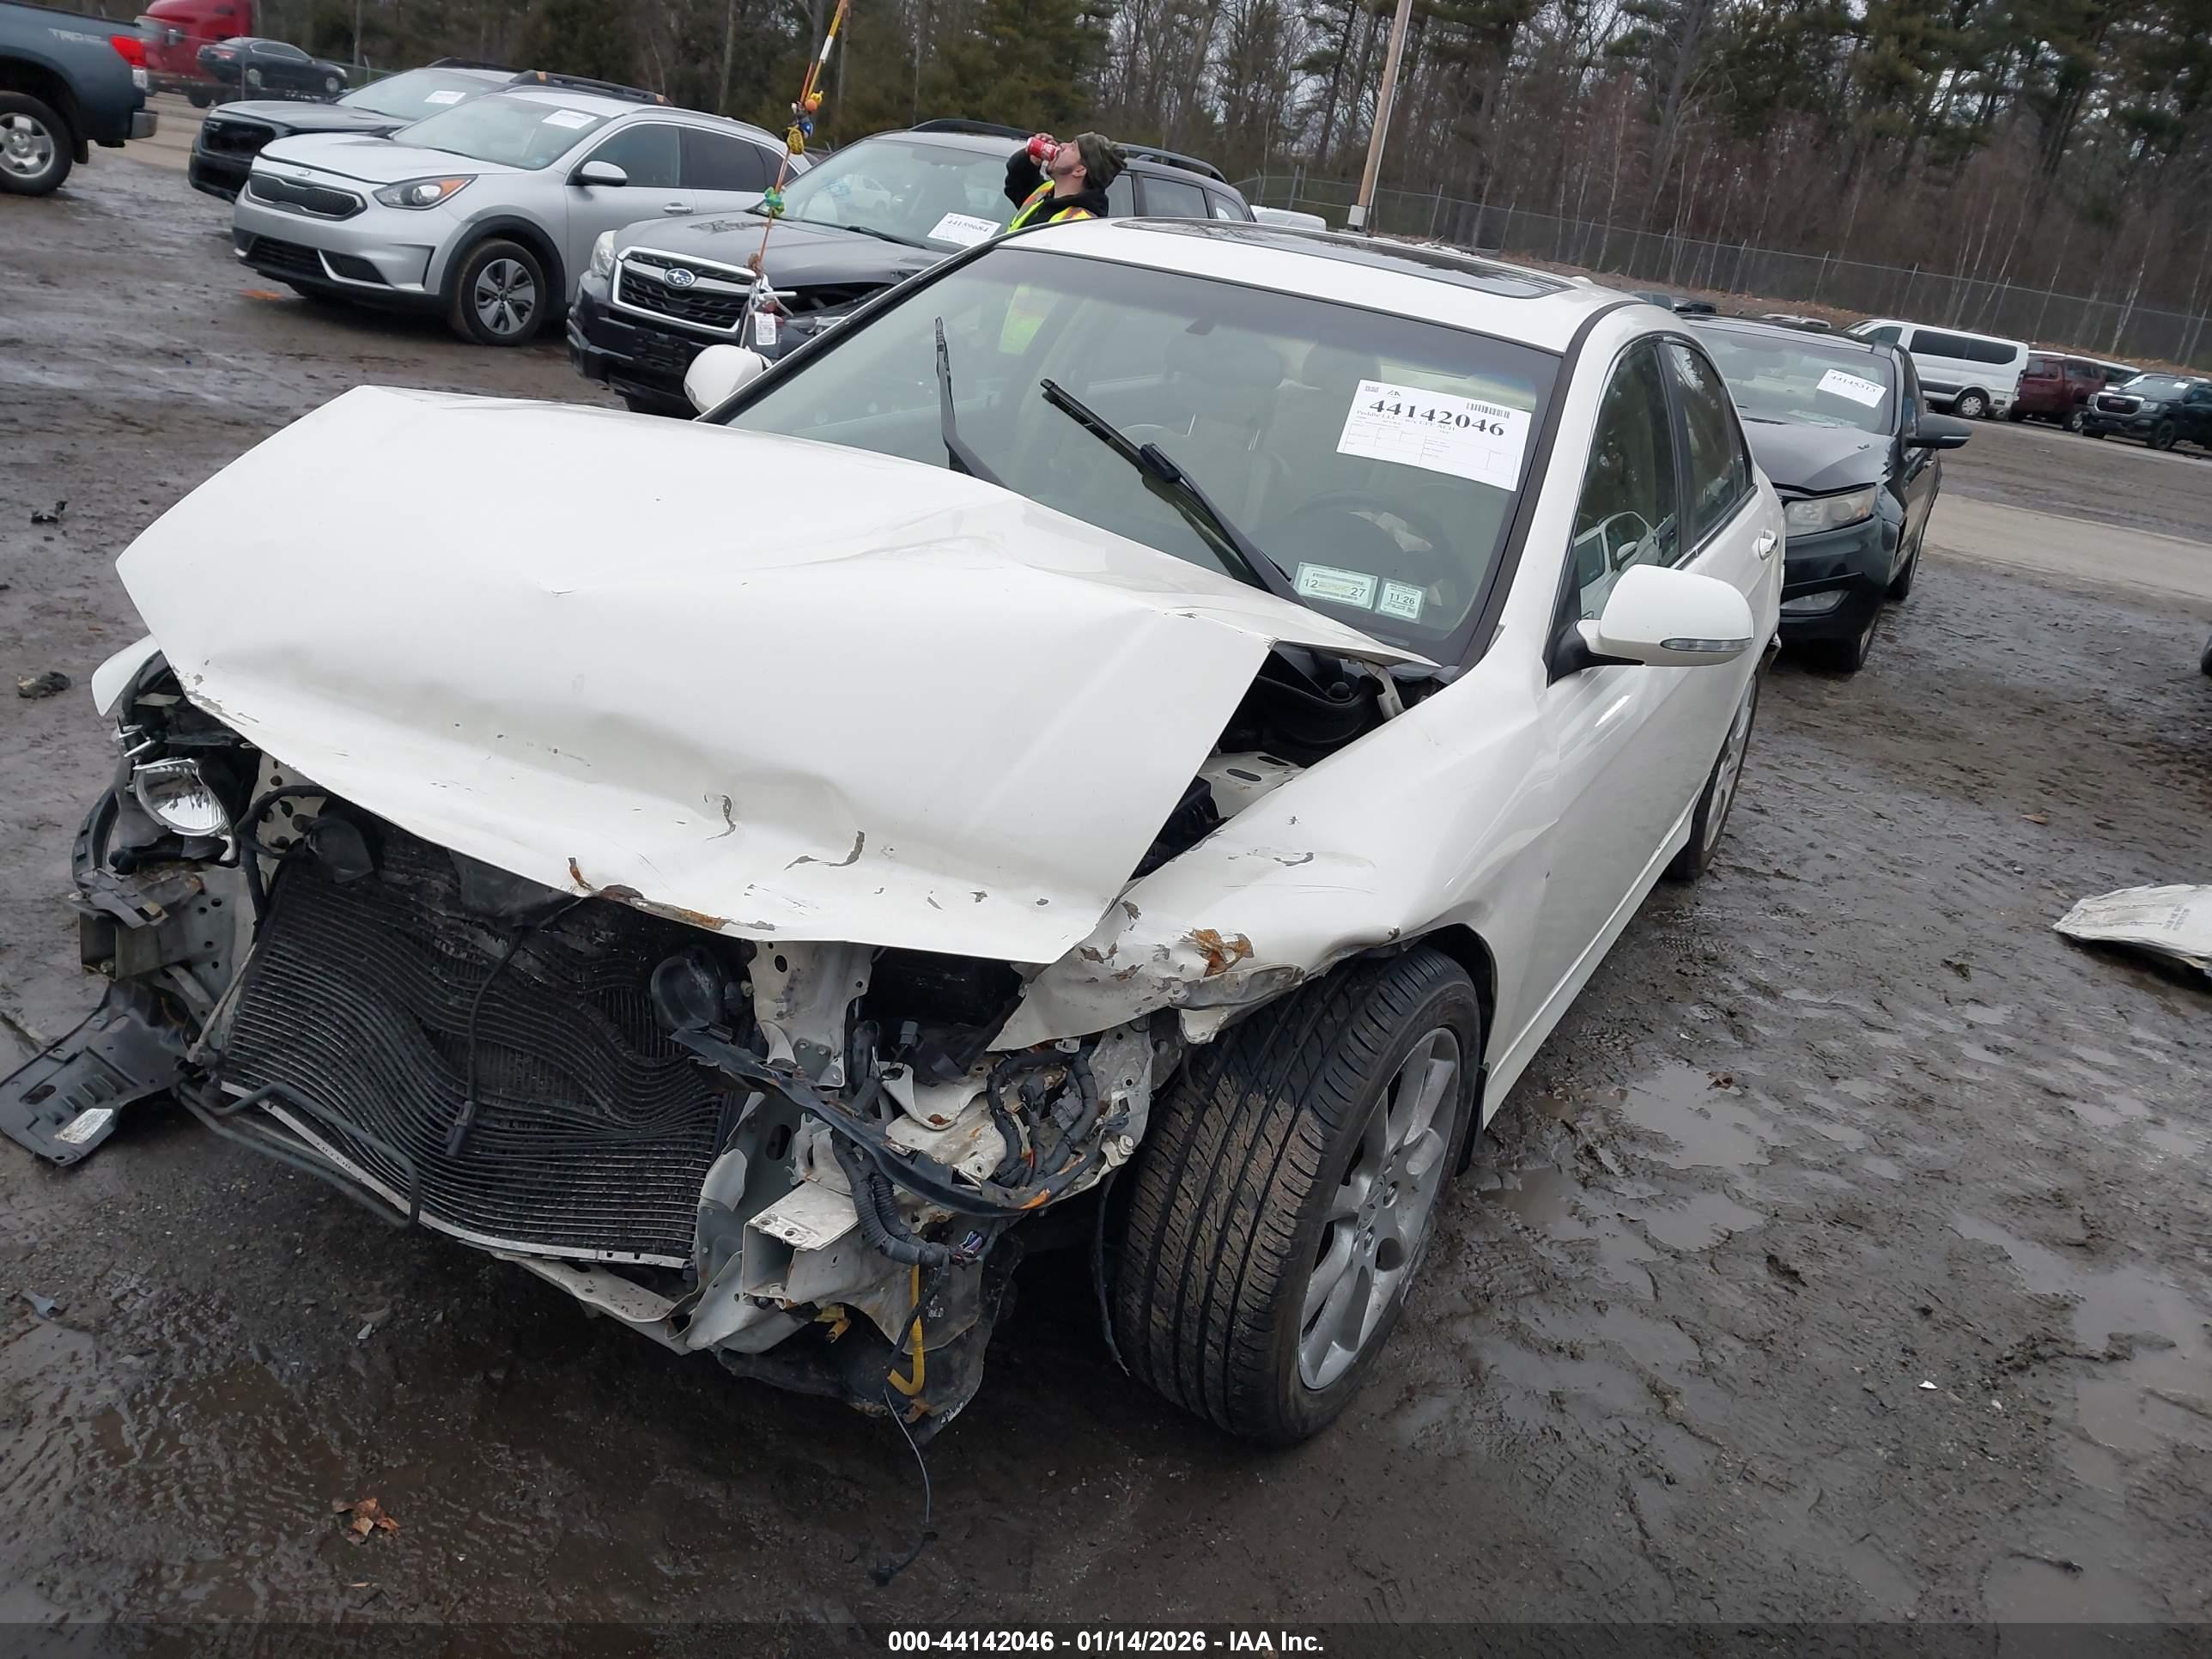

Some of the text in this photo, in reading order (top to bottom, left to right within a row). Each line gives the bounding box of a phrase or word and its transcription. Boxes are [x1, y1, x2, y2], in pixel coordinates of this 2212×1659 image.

[1369, 399, 1505, 436] 44142046
[1304, 578, 1319, 589] 12
[1350, 586, 1366, 599] 27
